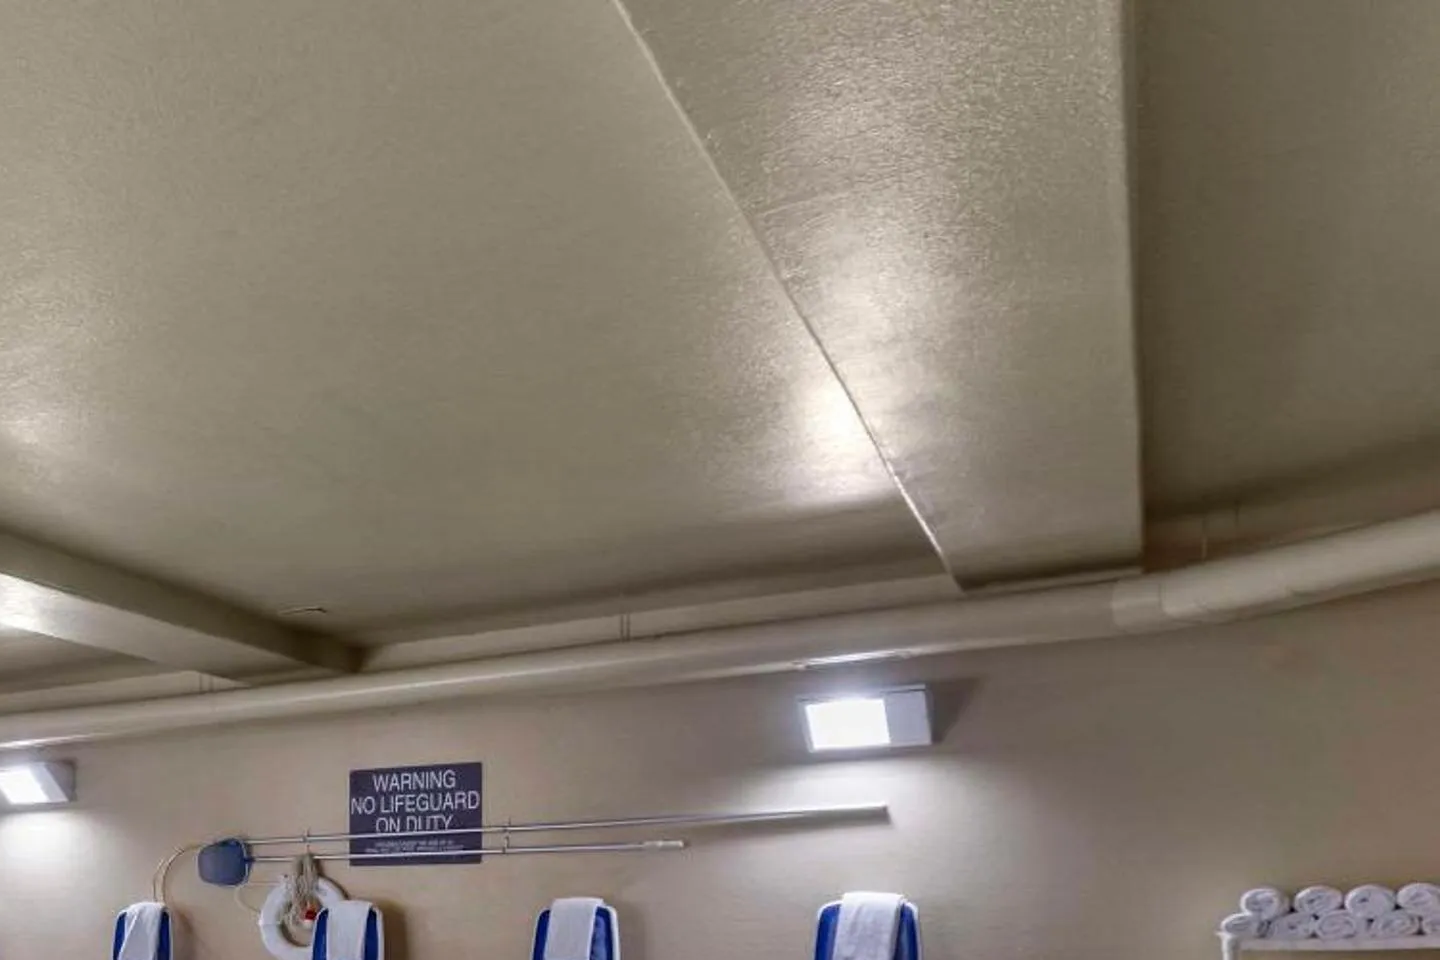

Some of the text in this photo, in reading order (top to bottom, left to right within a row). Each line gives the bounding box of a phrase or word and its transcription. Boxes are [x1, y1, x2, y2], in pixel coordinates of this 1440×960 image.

[372, 769, 456, 792] WARNING
[351, 790, 480, 815] NO LIFEGUARD
[375, 814, 454, 833] ON DUTY
